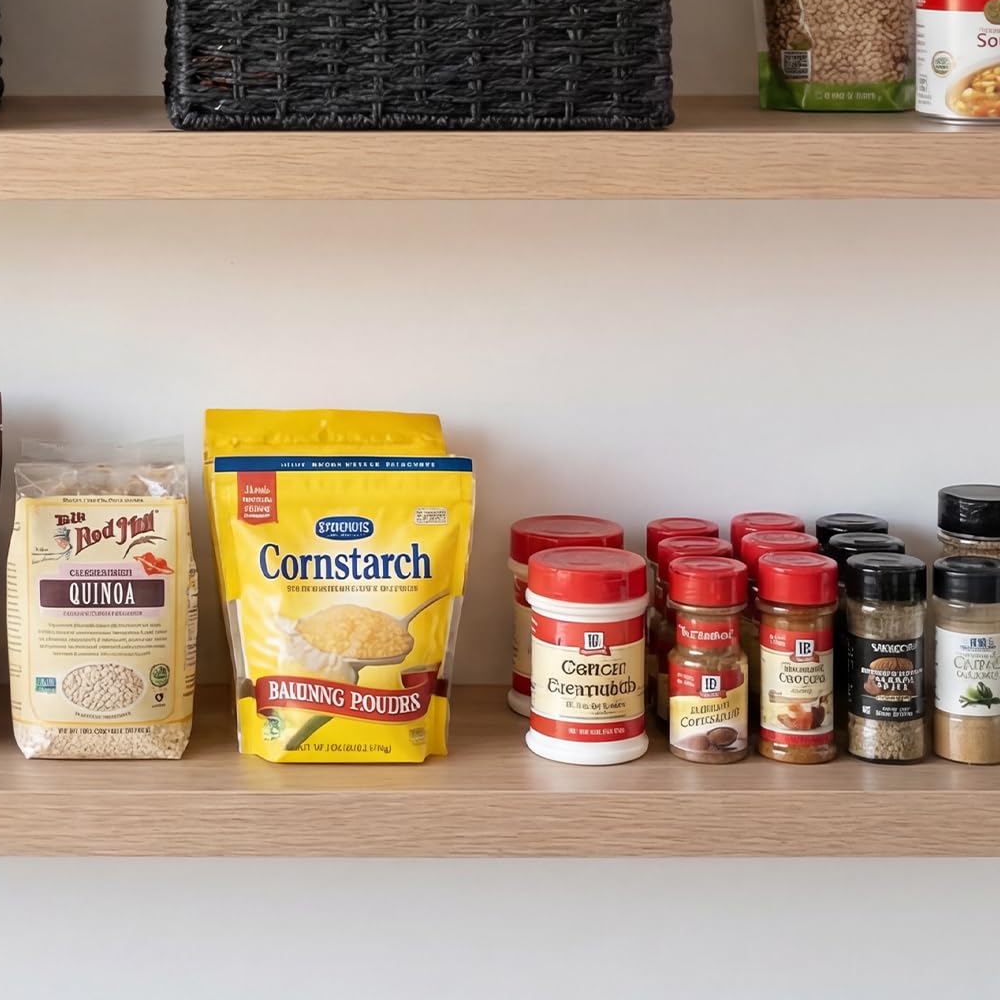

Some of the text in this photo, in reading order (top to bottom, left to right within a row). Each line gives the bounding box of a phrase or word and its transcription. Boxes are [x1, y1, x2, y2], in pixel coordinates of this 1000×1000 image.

[977, 33, 1000, 48] So
[260, 543, 432, 580] Cornstarch
[69, 582, 135, 605] QUINOA
